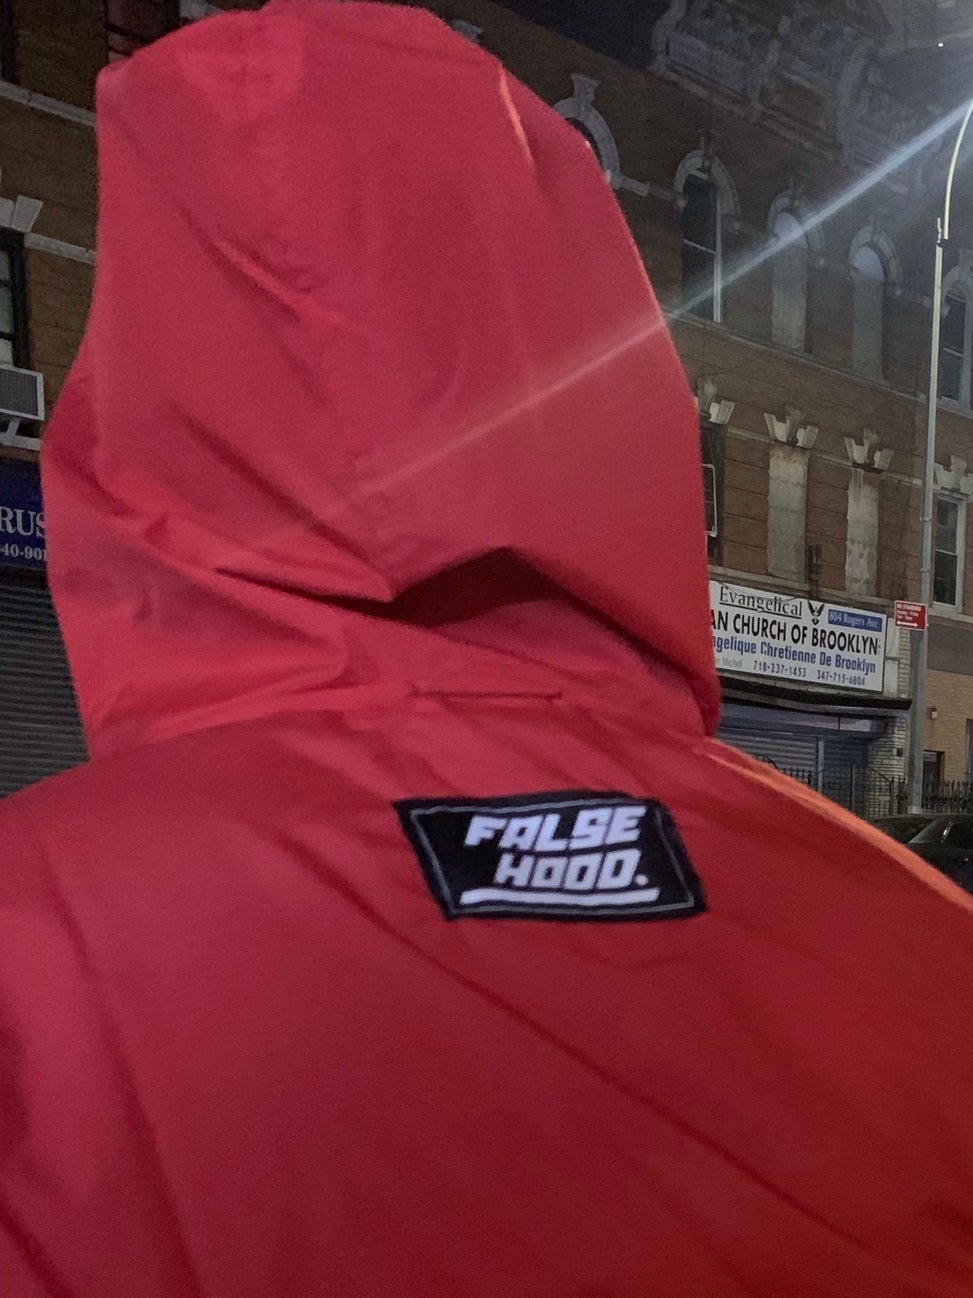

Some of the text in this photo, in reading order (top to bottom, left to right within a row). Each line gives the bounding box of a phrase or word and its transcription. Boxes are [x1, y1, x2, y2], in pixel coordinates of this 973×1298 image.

[719, 586, 802, 617] Evangelical
[733, 613, 786, 641] CHURCH
[791, 624, 808, 645] OF
[811, 628, 878, 655] BROOKLYN
[760, 641, 816, 664] Chretienne
[819, 652, 832, 667] De
[835, 656, 876, 676] Brooklyn
[464, 805, 646, 851] FALSE
[494, 849, 648, 889] HOOD.
